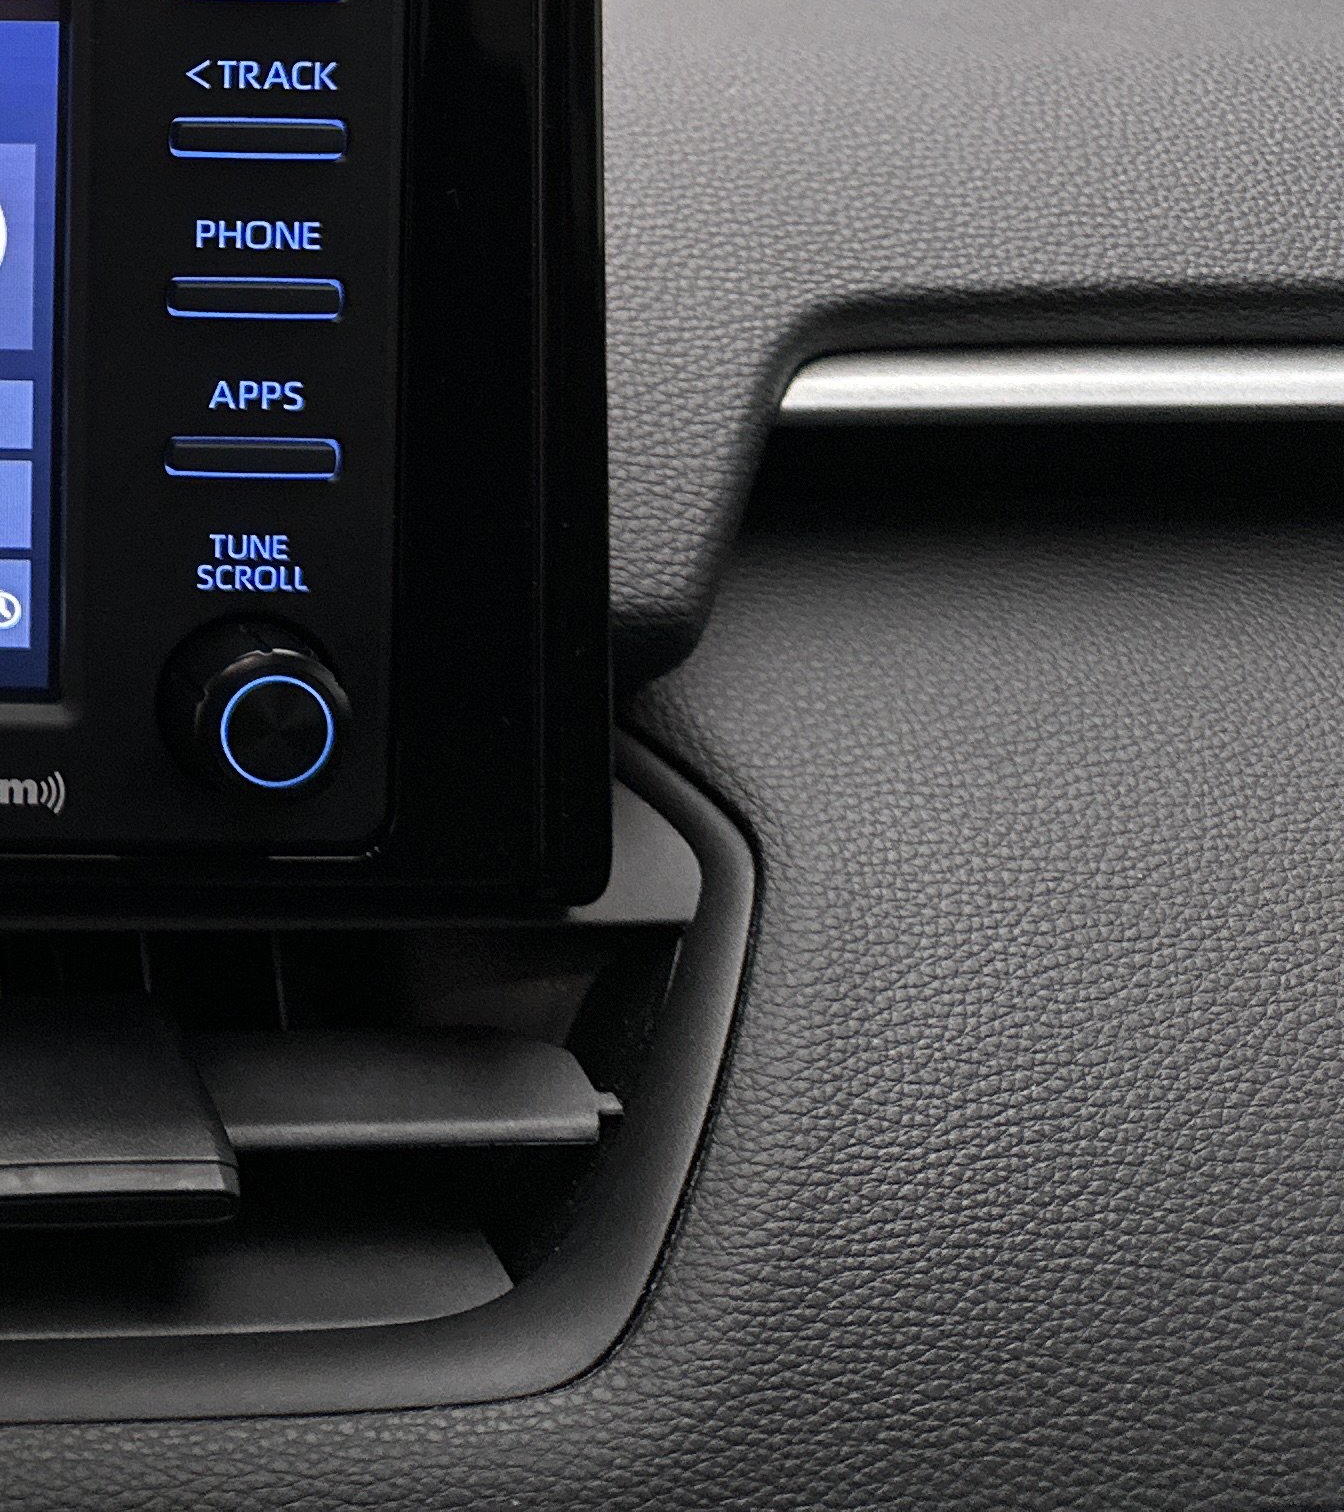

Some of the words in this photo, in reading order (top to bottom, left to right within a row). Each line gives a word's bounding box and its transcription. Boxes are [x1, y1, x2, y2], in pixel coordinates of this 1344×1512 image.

[195, 219, 323, 251] PHONE
[208, 380, 306, 411] APPS
[209, 534, 290, 561] TUNE
[196, 564, 310, 593] SCROLL
